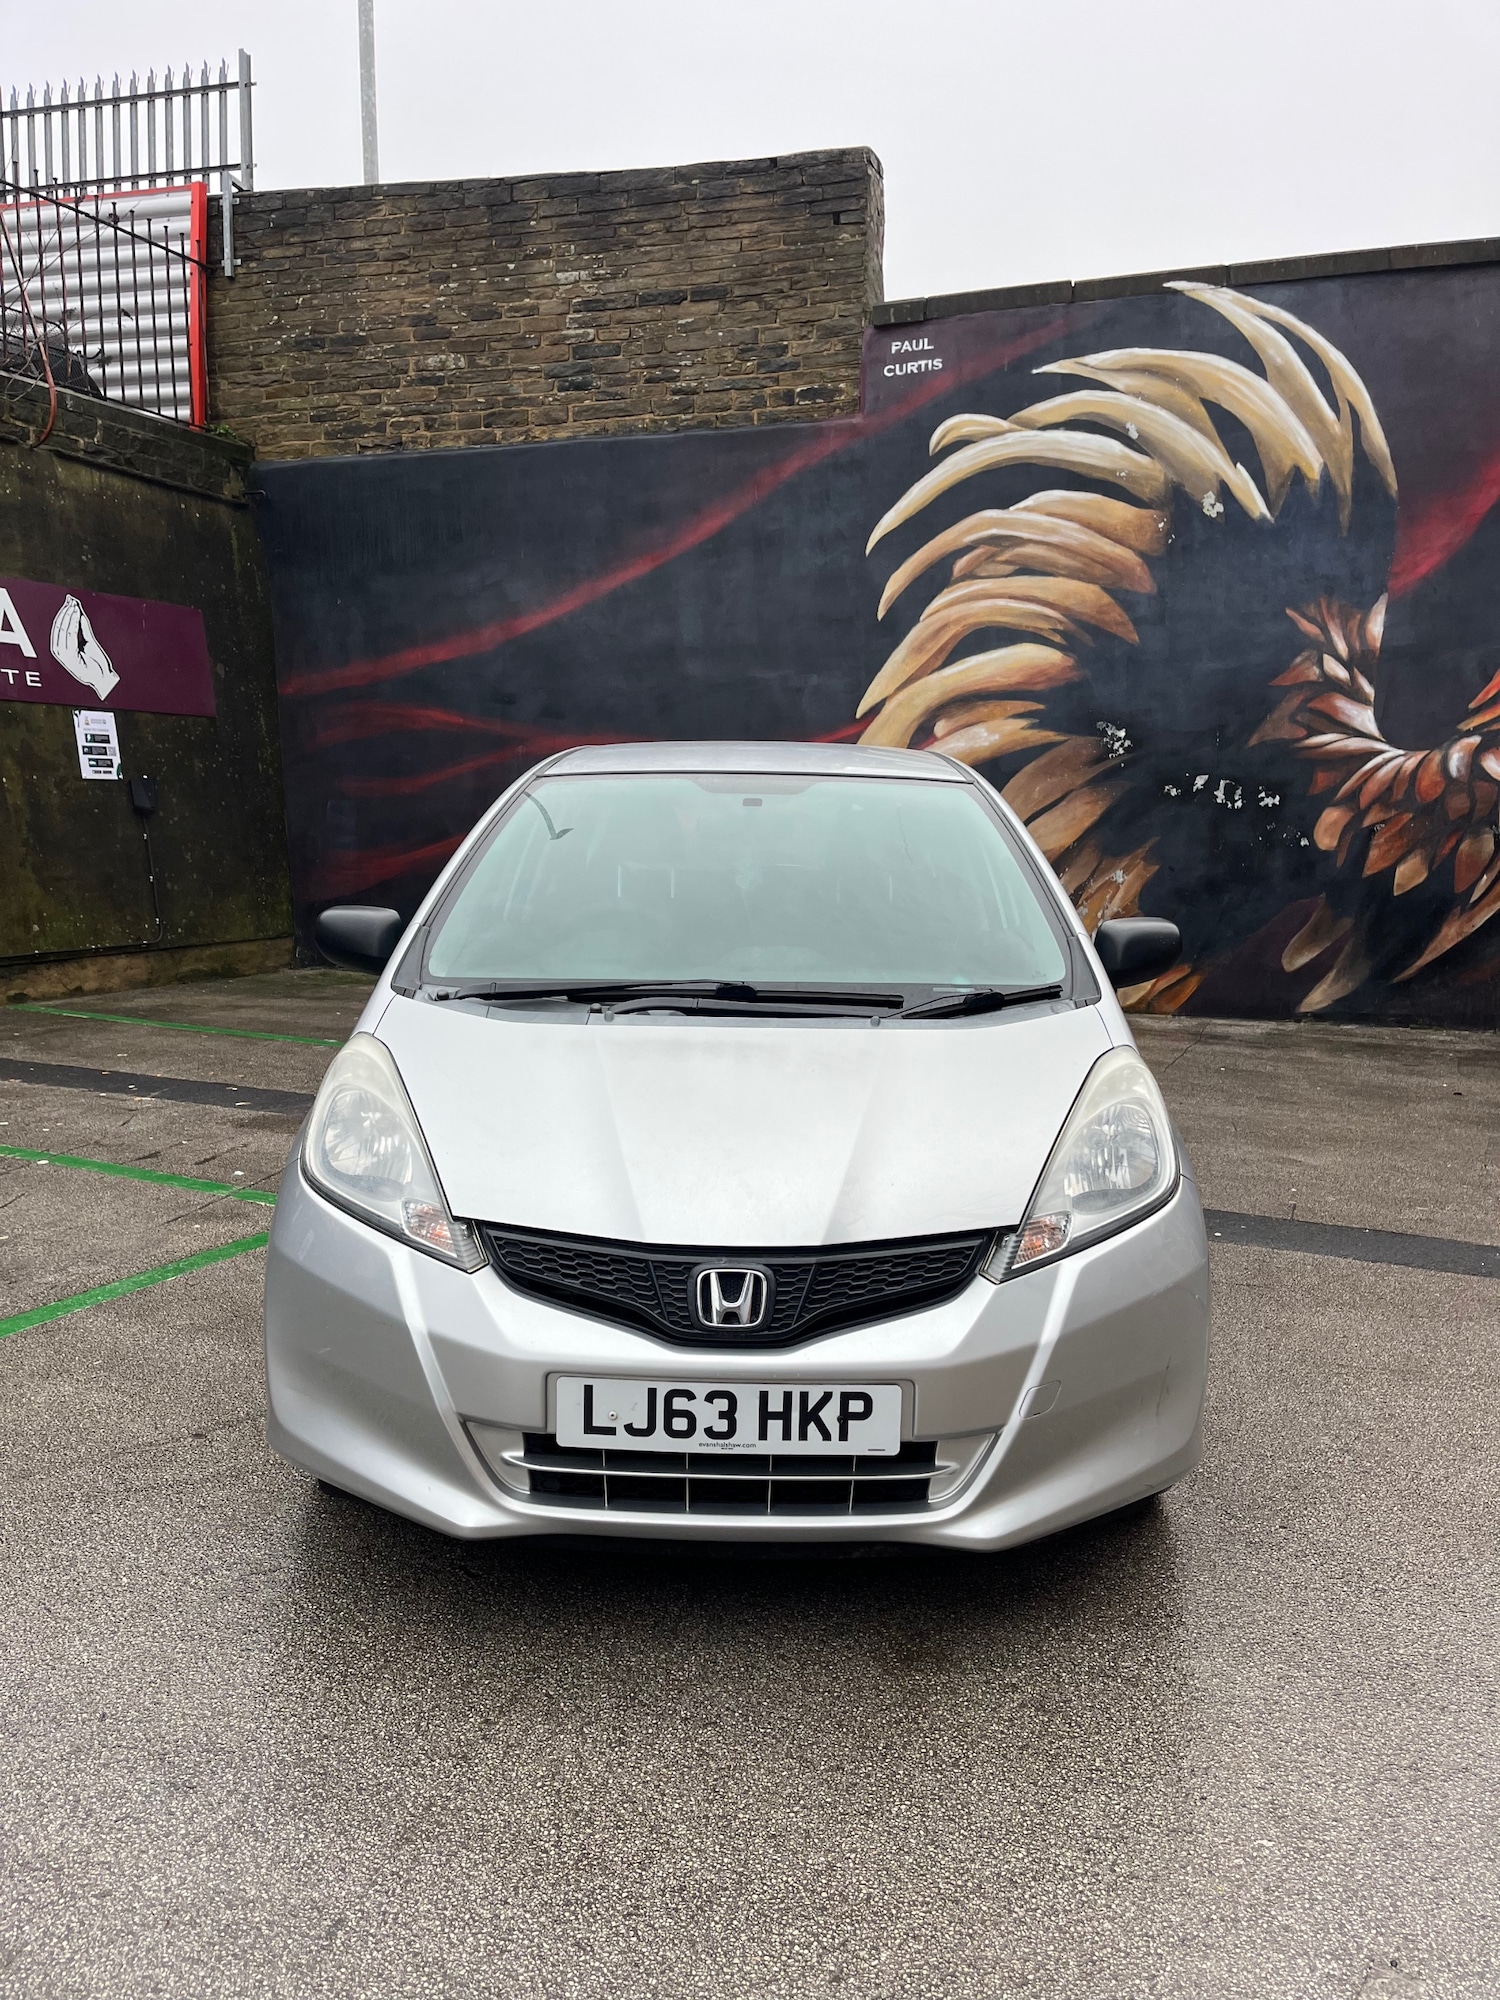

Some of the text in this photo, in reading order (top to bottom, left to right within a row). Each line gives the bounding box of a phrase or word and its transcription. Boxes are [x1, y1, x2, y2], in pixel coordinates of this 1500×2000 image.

[891, 337, 934, 354] PAUL
[883, 358, 943, 377] CURTIS
[0, 587, 38, 658] A
[0, 668, 42, 687] TE
[583, 1384, 873, 1442] LJ63 HKP
[698, 1441, 757, 1449] evanshalshaw.com
